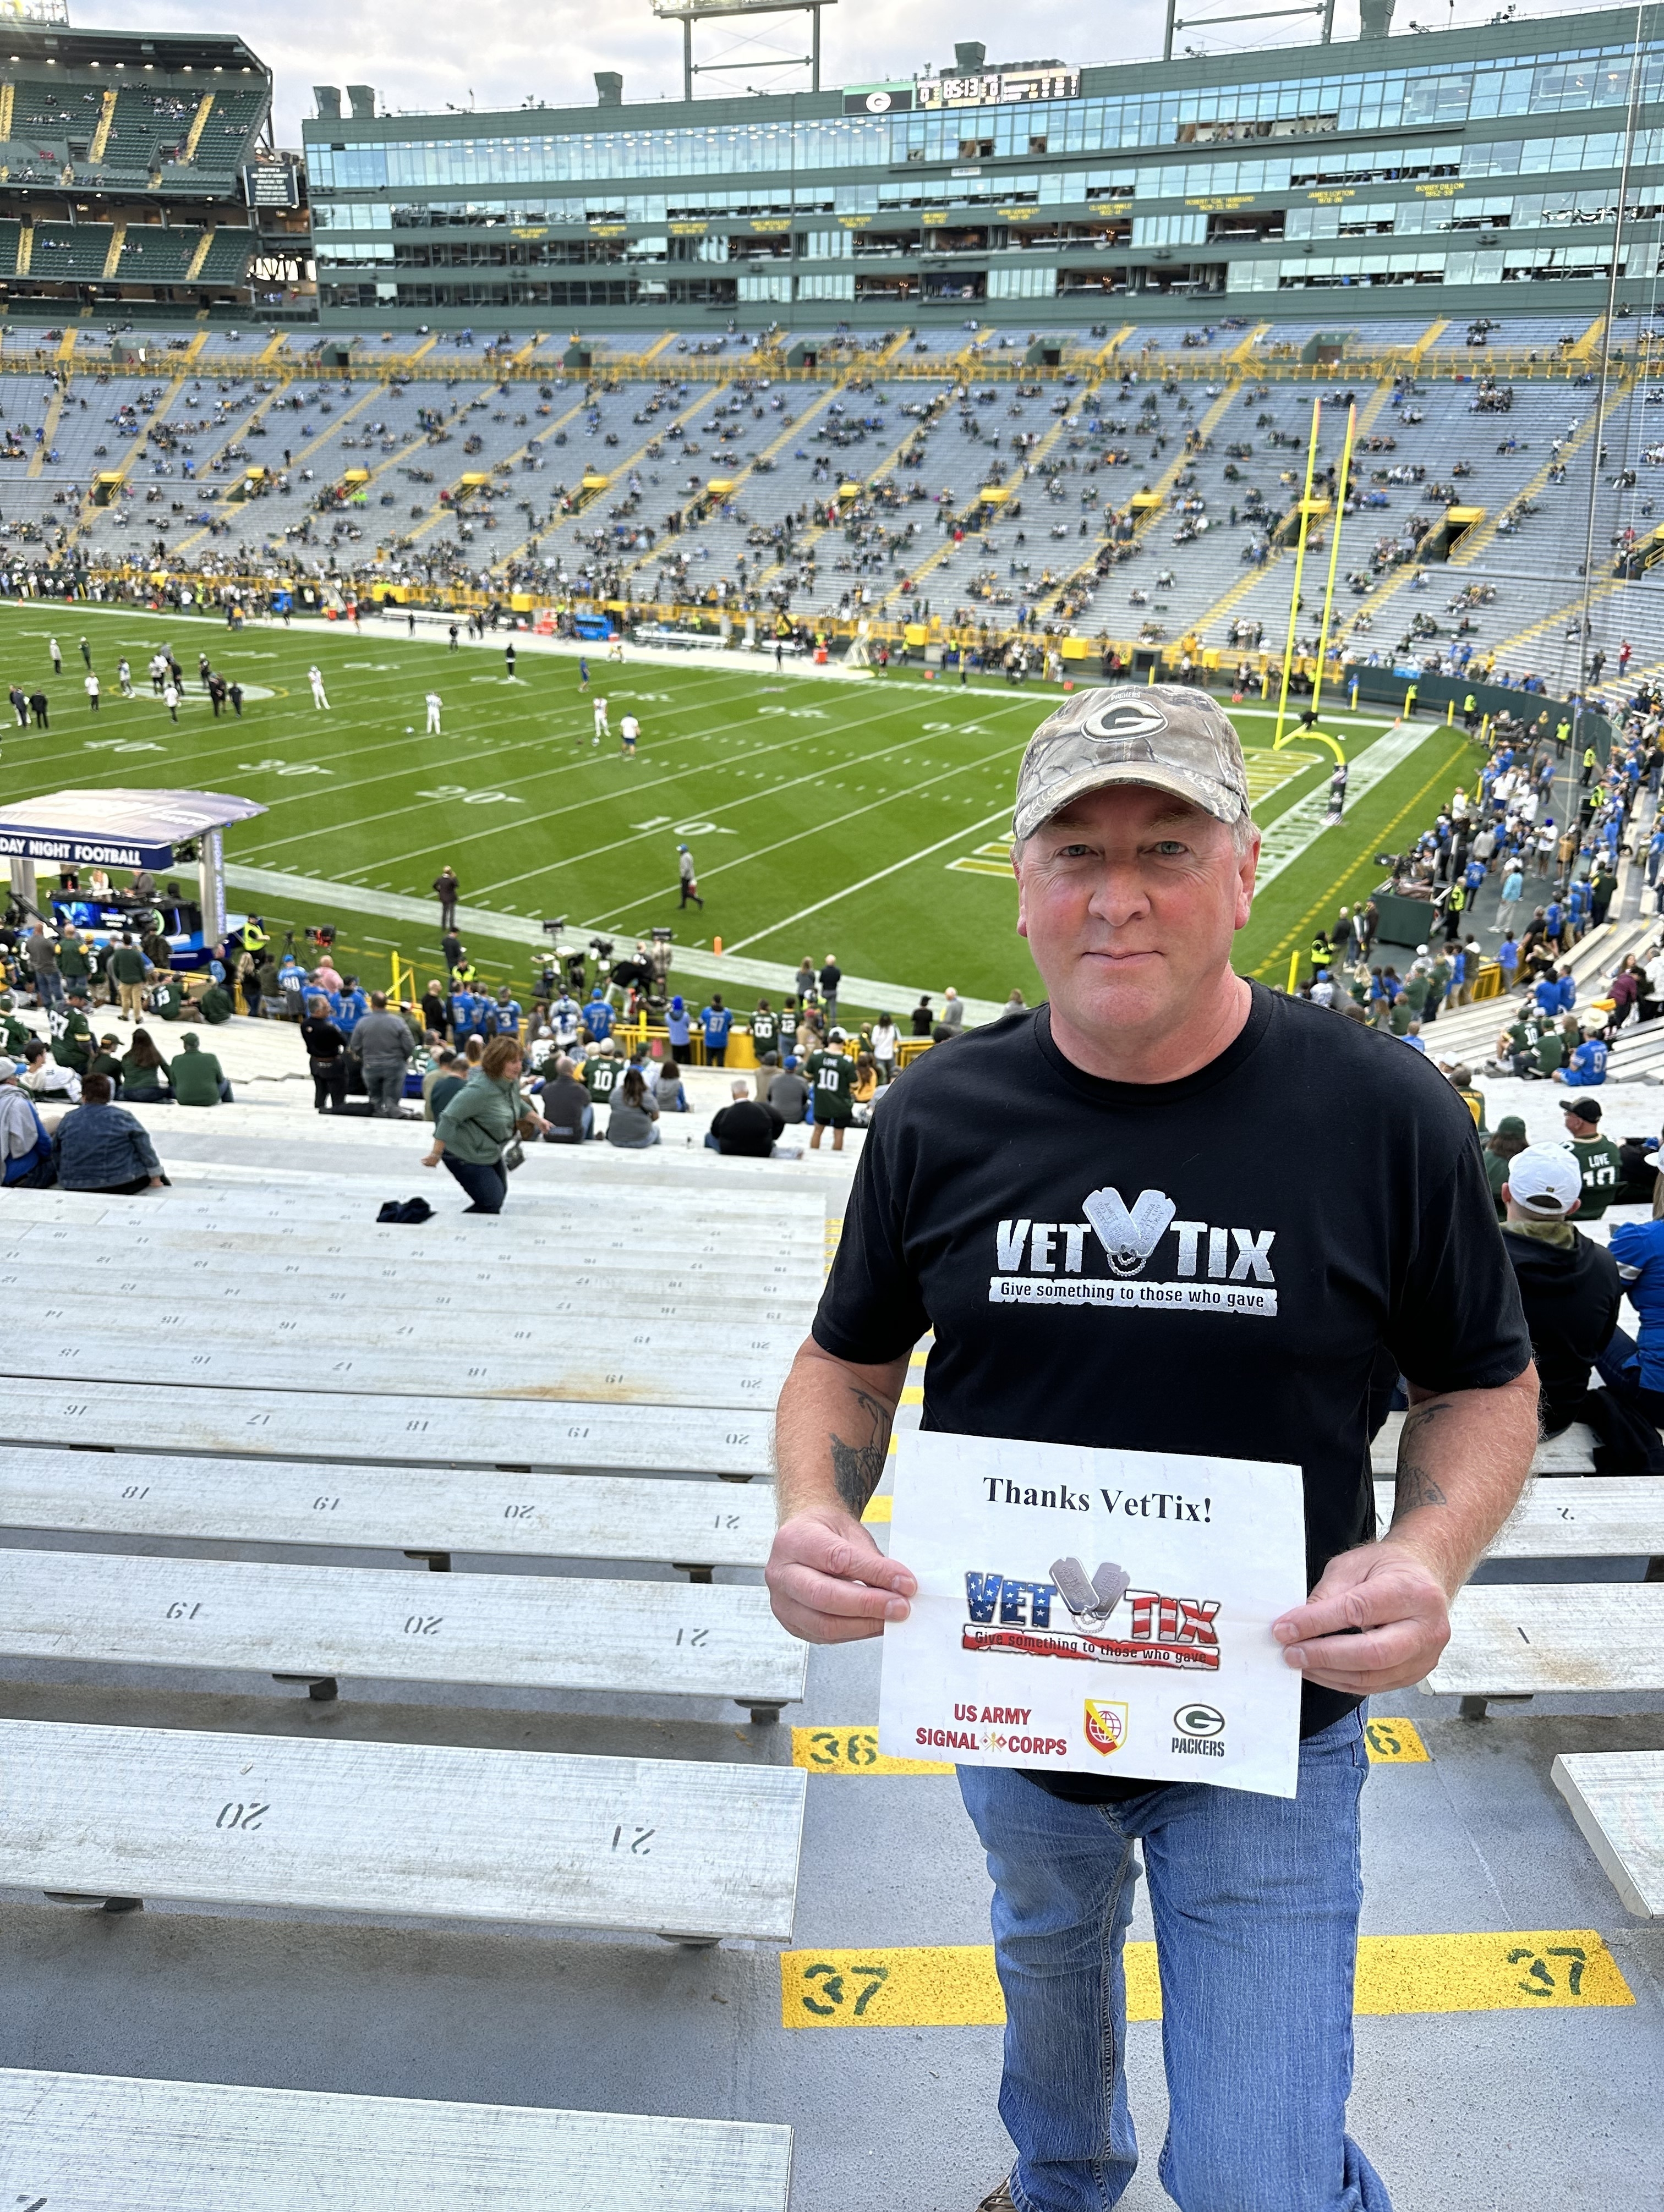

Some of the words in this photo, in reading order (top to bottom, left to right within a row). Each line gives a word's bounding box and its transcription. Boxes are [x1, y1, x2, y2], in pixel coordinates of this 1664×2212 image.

[238, 759, 320, 776] 30
[415, 785, 506, 804] 20
[628, 816, 716, 836] 10
[29, 839, 72, 859] NIGHT
[74, 844, 142, 866] FOOTBALL
[339, 1002, 356, 1019] 77
[49, 1010, 69, 1041] 87
[593, 1069, 614, 1092] 10
[817, 1068, 839, 1092] 10
[1588, 1152, 1610, 1168] LOVE
[995, 1219, 1092, 1273] VET
[1169, 1220, 1277, 1283] TIX
[1000, 1281, 1032, 1298] Give
[1036, 1283, 1115, 1302] something
[1120, 1286, 1135, 1300] to
[1140, 1287, 1183, 1303] those
[1188, 1288, 1221, 1304] who
[1227, 1293, 1265, 1309] gave
[396, 1326, 414, 1334] 17
[193, 1355, 211, 1364] 16
[332, 1362, 353, 1371] 17
[468, 1368, 487, 1376] 18
[605, 1374, 623, 1384] 19
[741, 1380, 762, 1388] 20
[67, 1404, 87, 1416] 16
[246, 1414, 270, 1425] 17
[406, 1420, 429, 1431] 18
[568, 1427, 589, 1438] 19
[726, 1434, 749, 1444] 20
[122, 1486, 150, 1500] 18
[983, 1477, 1091, 1512] Thanks
[1099, 1488, 1212, 1524] VetTix!
[313, 1496, 340, 1510] 19
[504, 1505, 535, 1518] 20
[714, 1515, 740, 1529] 21
[166, 1602, 201, 1620] 19
[965, 1570, 1058, 1628] VET
[1124, 1590, 1222, 1644] TIX
[404, 1616, 443, 1635] 20
[676, 1628, 709, 1648] 21
[1517, 1627, 1530, 1644] 1
[974, 1630, 1004, 1646] Give
[1008, 1633, 1078, 1654] something
[1082, 1639, 1096, 1654] to
[1100, 1644, 1138, 1659] those
[1142, 1648, 1170, 1661] who
[1174, 1650, 1207, 1664] gave
[954, 1703, 977, 1722] US
[980, 1705, 1032, 1725] ARMY
[810, 1733, 877, 1765] 36
[916, 1727, 980, 1751] SIGNAL
[1007, 1735, 1068, 1756] CORPS
[1171, 1737, 1225, 1758] PACKERS
[216, 1802, 270, 1831] 20
[612, 1825, 655, 1855] 21
[1507, 1947, 1587, 1997] 37
[802, 1964, 889, 2016] 37
